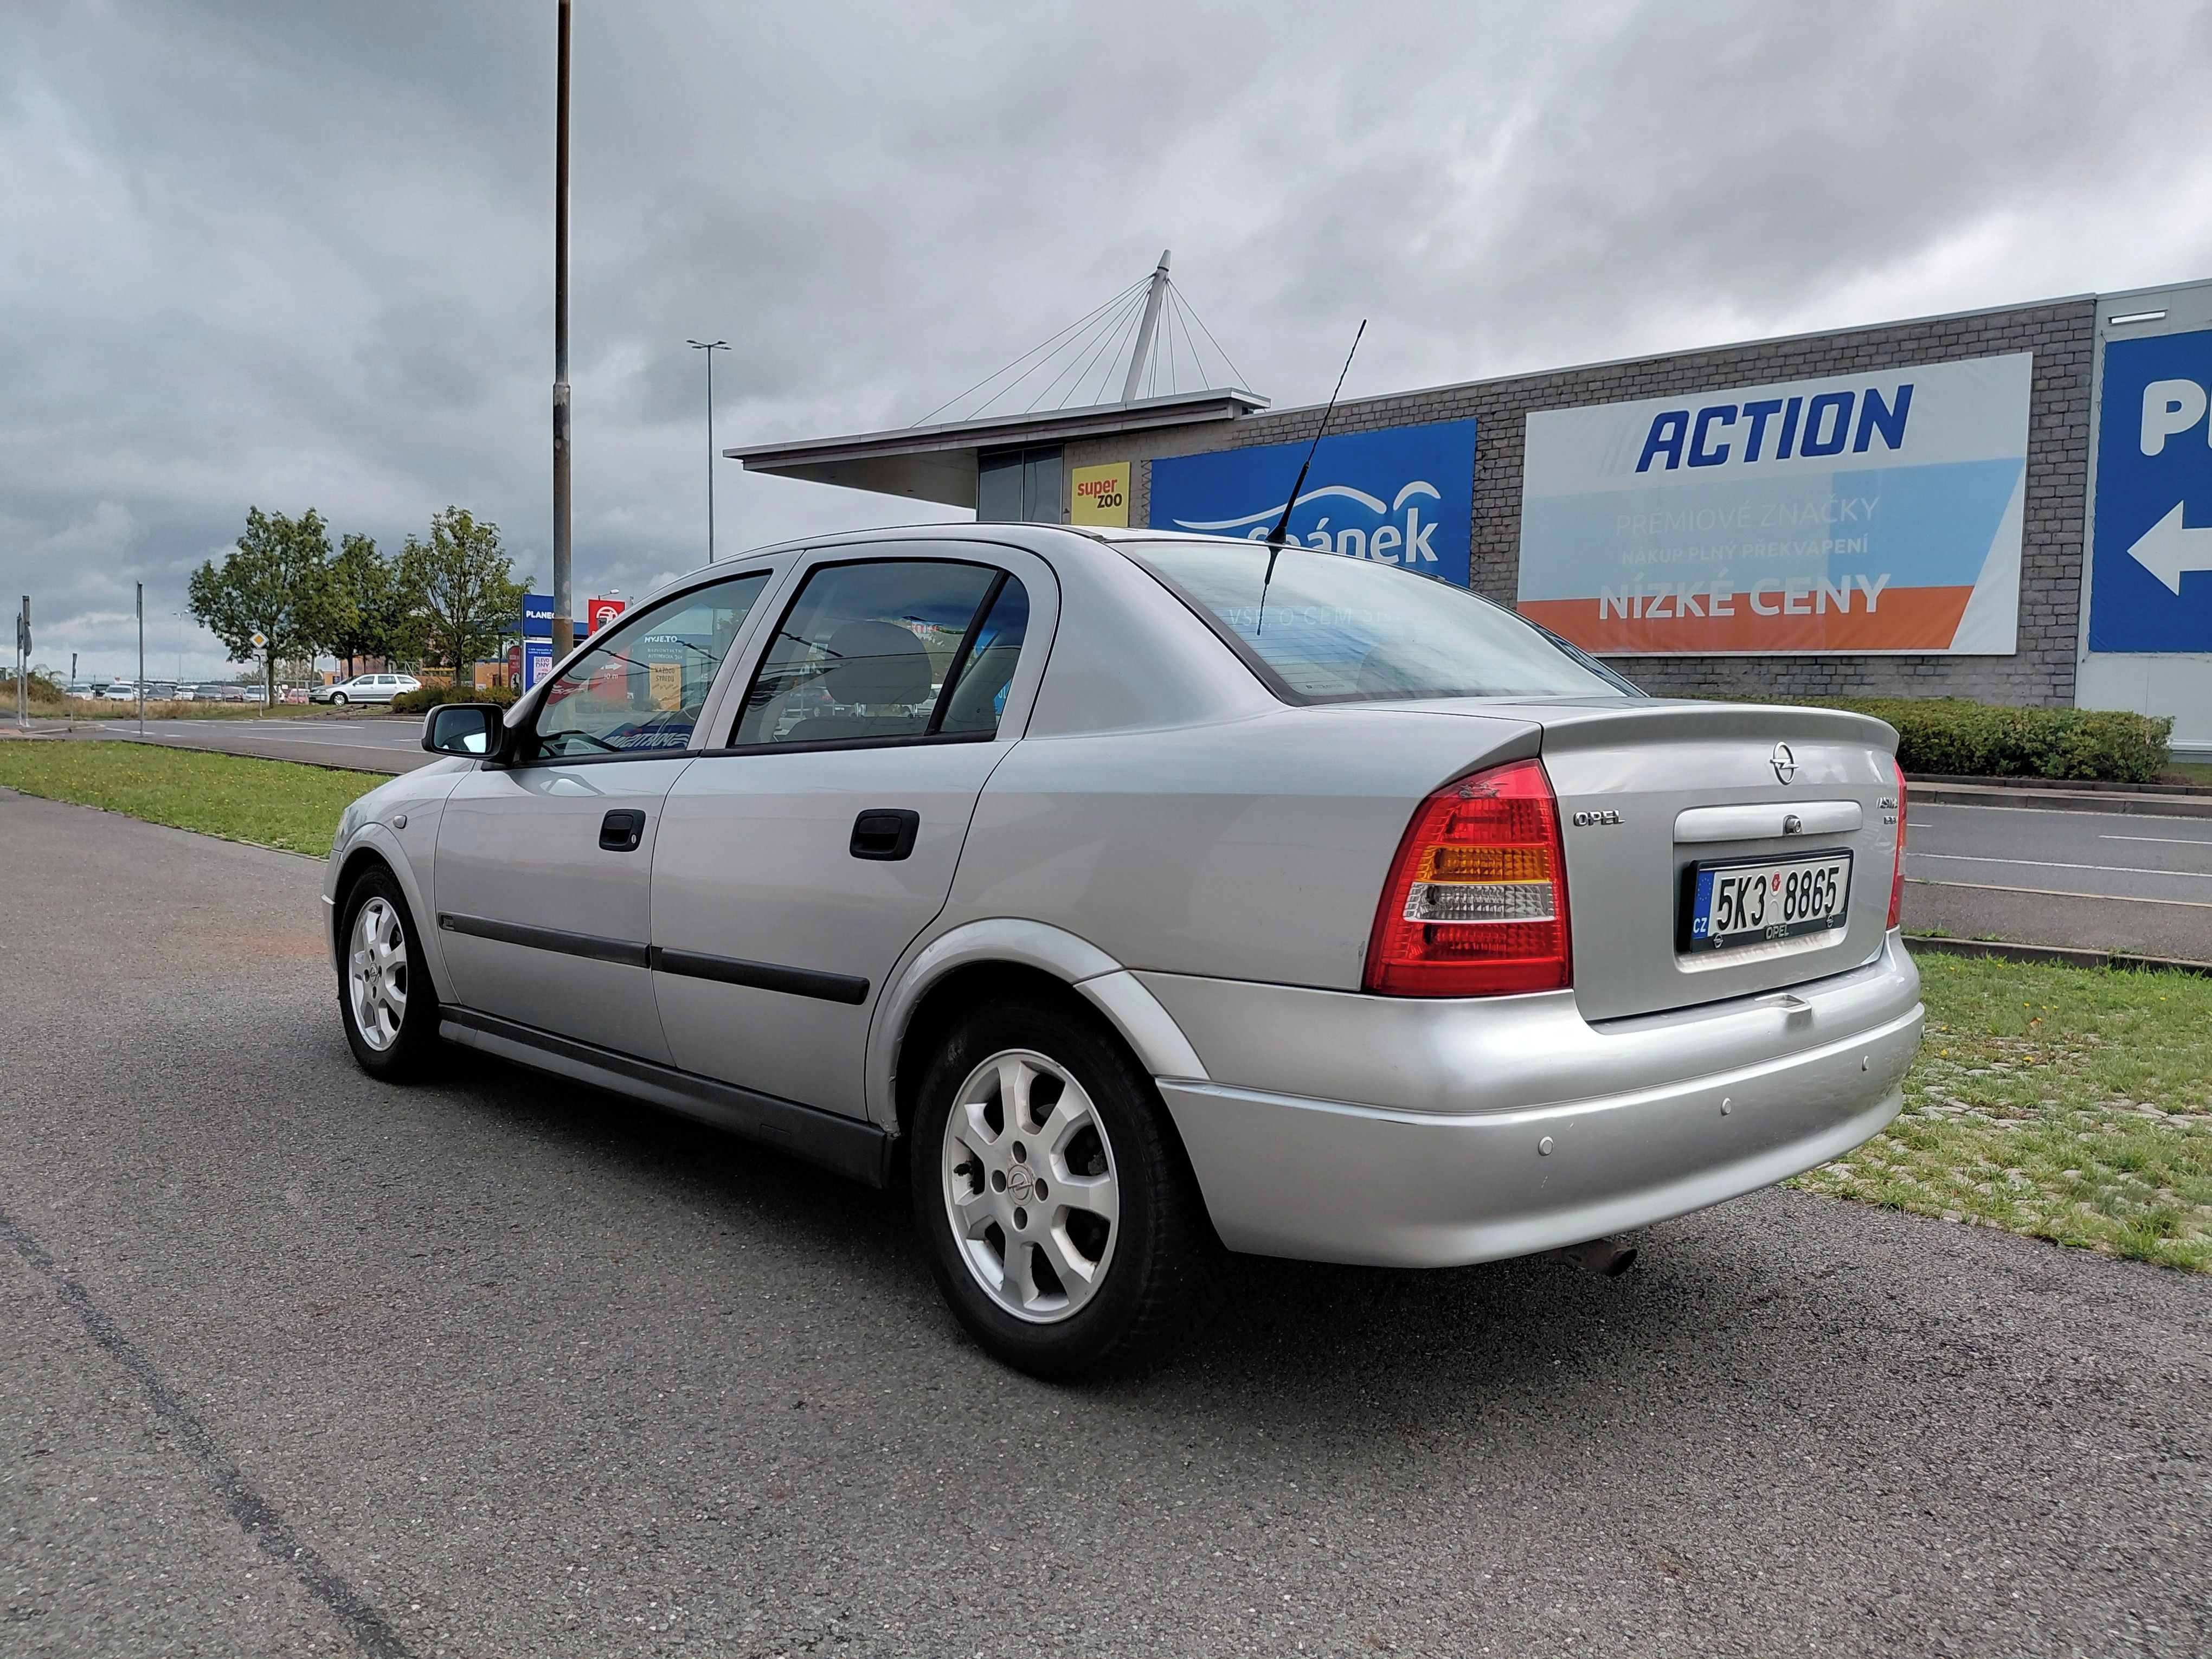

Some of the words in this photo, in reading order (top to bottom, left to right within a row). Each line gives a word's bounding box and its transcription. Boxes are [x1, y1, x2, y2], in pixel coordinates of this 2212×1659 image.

[1635, 383, 1915, 473] ACTION
[2140, 379, 2212, 456] P
[1077, 479, 1118, 499] super
[1248, 507, 1439, 564] ánek
[1616, 500, 1753, 536] PRÉMIOVÉ
[1760, 493, 1880, 528] ZNAČKY
[1622, 545, 1683, 564] NÁKUP
[1688, 542, 1736, 561] PLNÝ
[1742, 533, 1869, 558] PŘEKVAPENÍ
[1599, 567, 1735, 620] NÍZKÉ
[1749, 573, 1893, 616] CENY
[1573, 809, 1625, 827] OPEL
[1716, 873, 1767, 931] 5K3
[1783, 865, 1840, 921] 8865
[1693, 917, 1708, 934] CZ
[1765, 925, 1790, 940] OPEL
